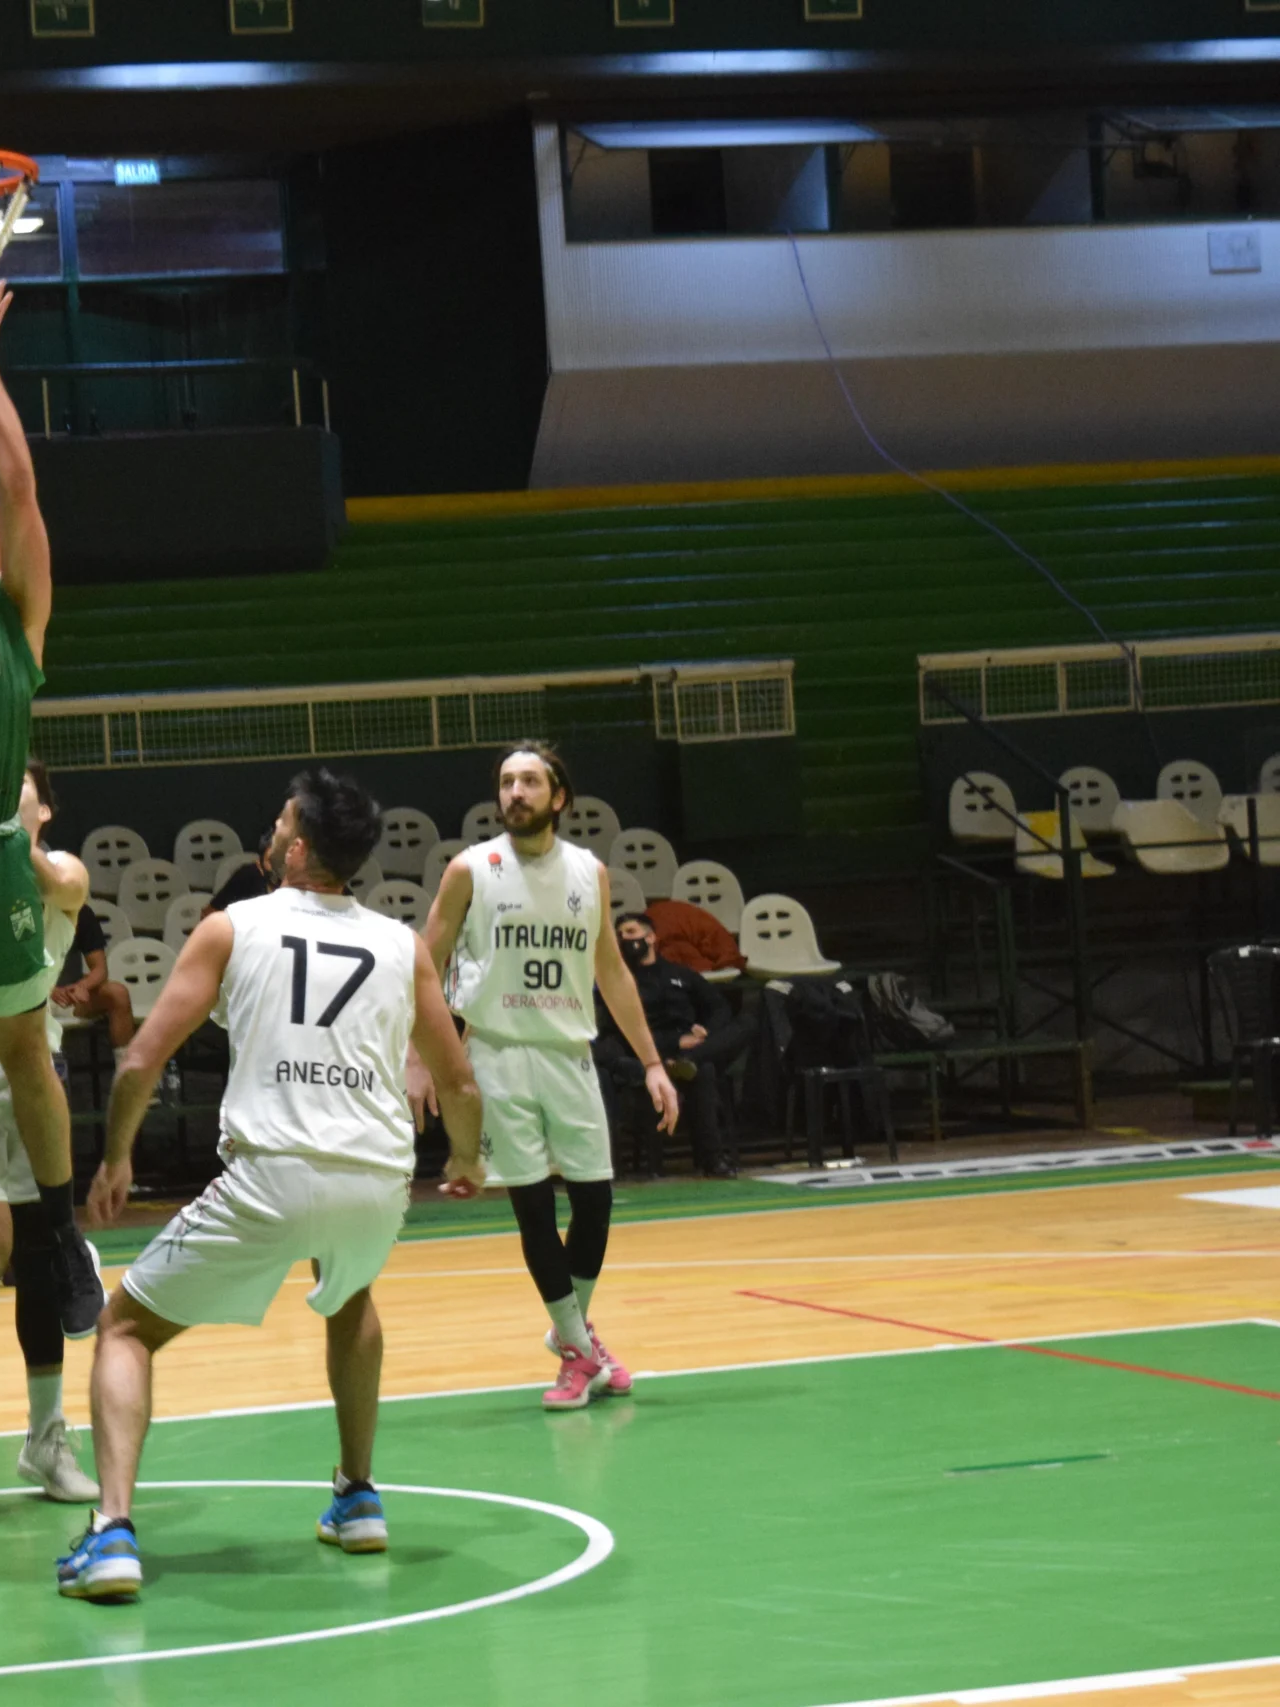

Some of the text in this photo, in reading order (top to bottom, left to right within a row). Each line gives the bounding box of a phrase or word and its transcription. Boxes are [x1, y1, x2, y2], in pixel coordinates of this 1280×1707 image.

[115, 162, 158, 185] SALIDA
[495, 924, 587, 952] ITALIANO
[281, 934, 376, 1028] 17
[523, 959, 562, 990] 90
[276, 1059, 374, 1093] ANEGON
